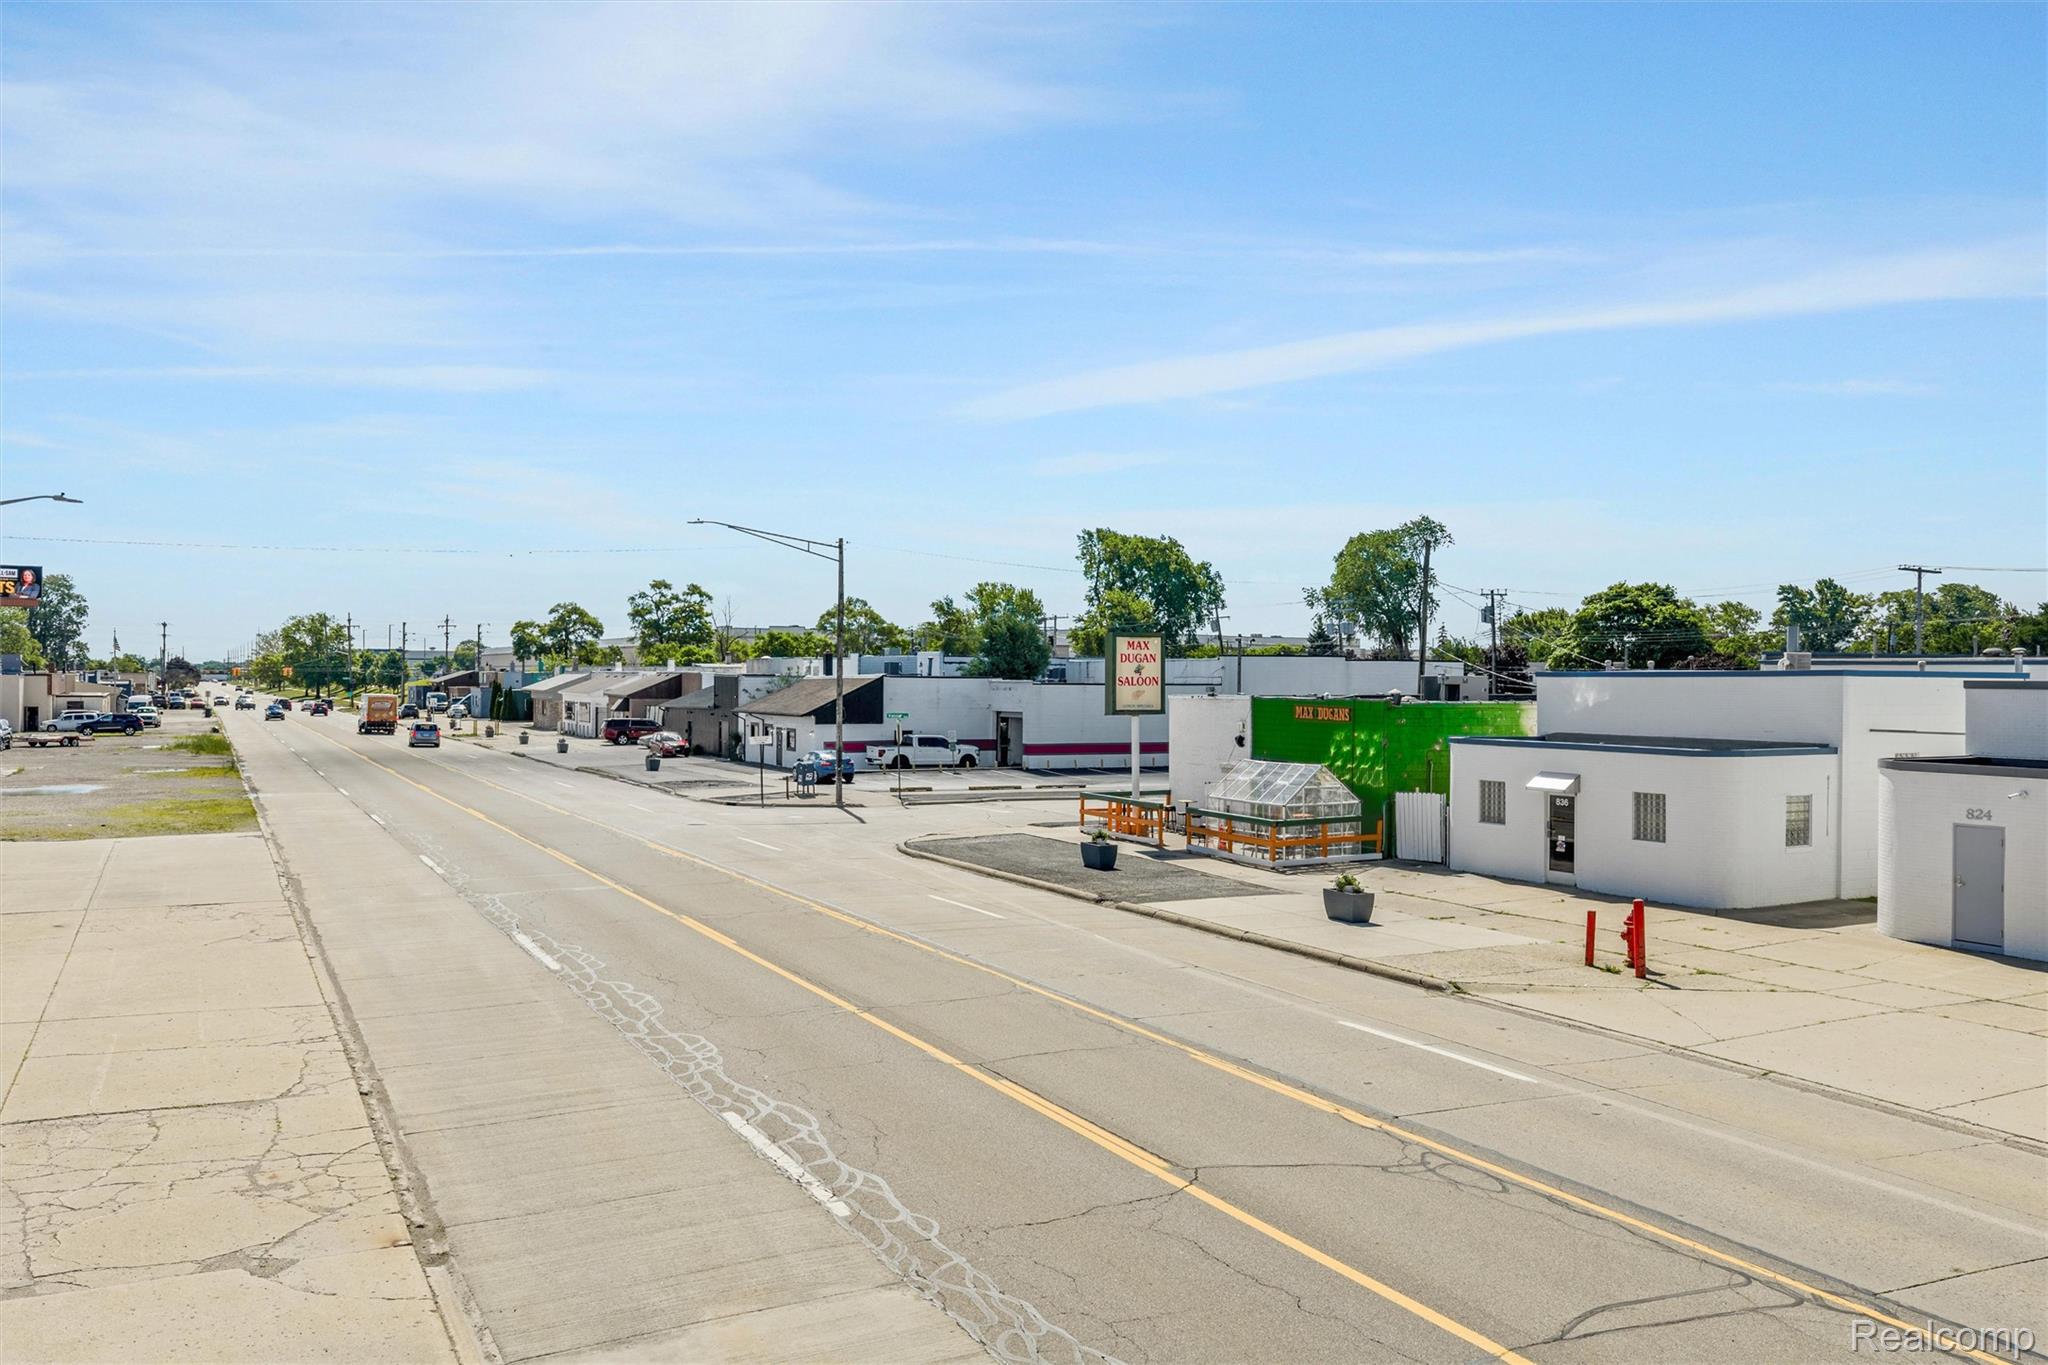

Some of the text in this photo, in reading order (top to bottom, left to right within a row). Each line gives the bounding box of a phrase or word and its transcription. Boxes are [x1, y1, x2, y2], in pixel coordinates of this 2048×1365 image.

[1127, 641, 1150, 650] MAX
[1120, 653, 1157, 663] DUGAN
[1117, 676, 1159, 686] SALOON
[1296, 706, 1350, 721] MAX DUGANS
[1555, 797, 1569, 807] 836
[1966, 808, 1992, 821] 824
